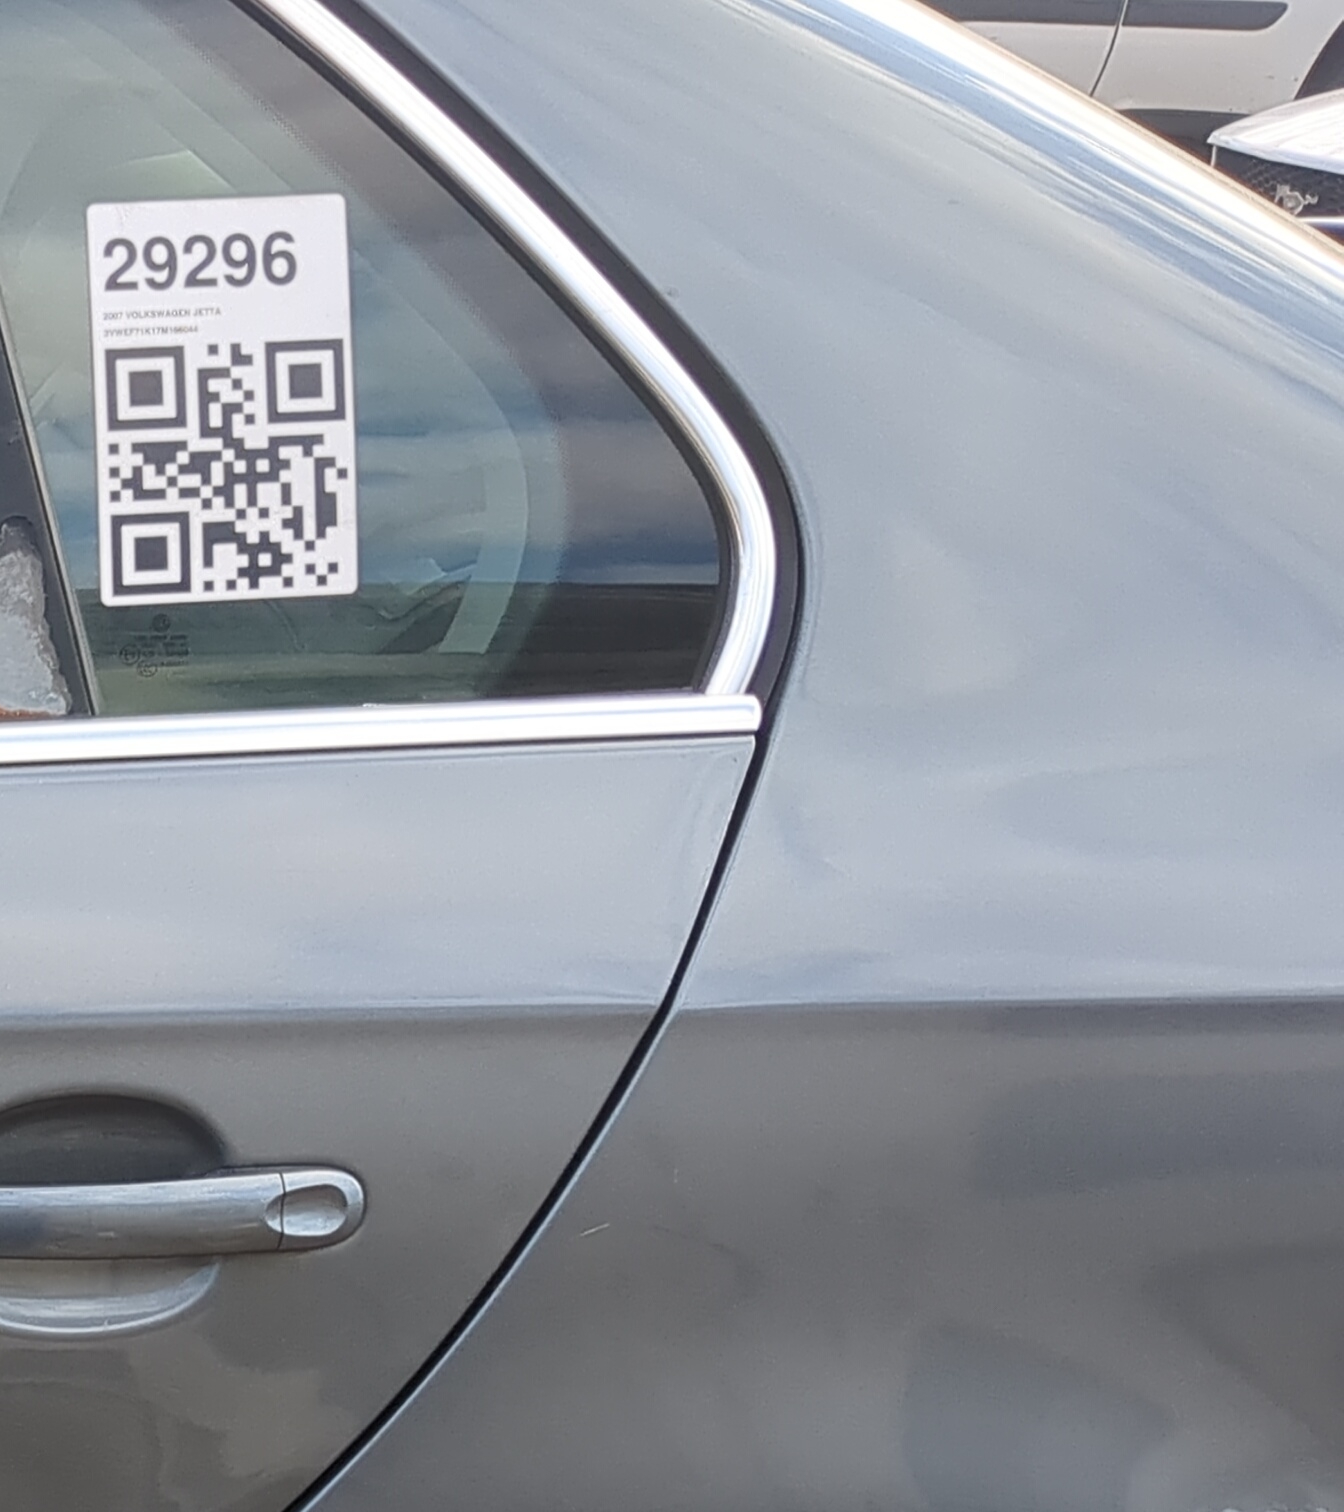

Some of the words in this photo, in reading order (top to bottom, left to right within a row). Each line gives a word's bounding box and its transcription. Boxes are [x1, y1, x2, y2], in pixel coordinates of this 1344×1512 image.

[103, 230, 297, 291] 29296
[103, 311, 123, 321] 2007
[126, 308, 191, 320] VOLKSWAGEN
[193, 306, 221, 317] JETTA
